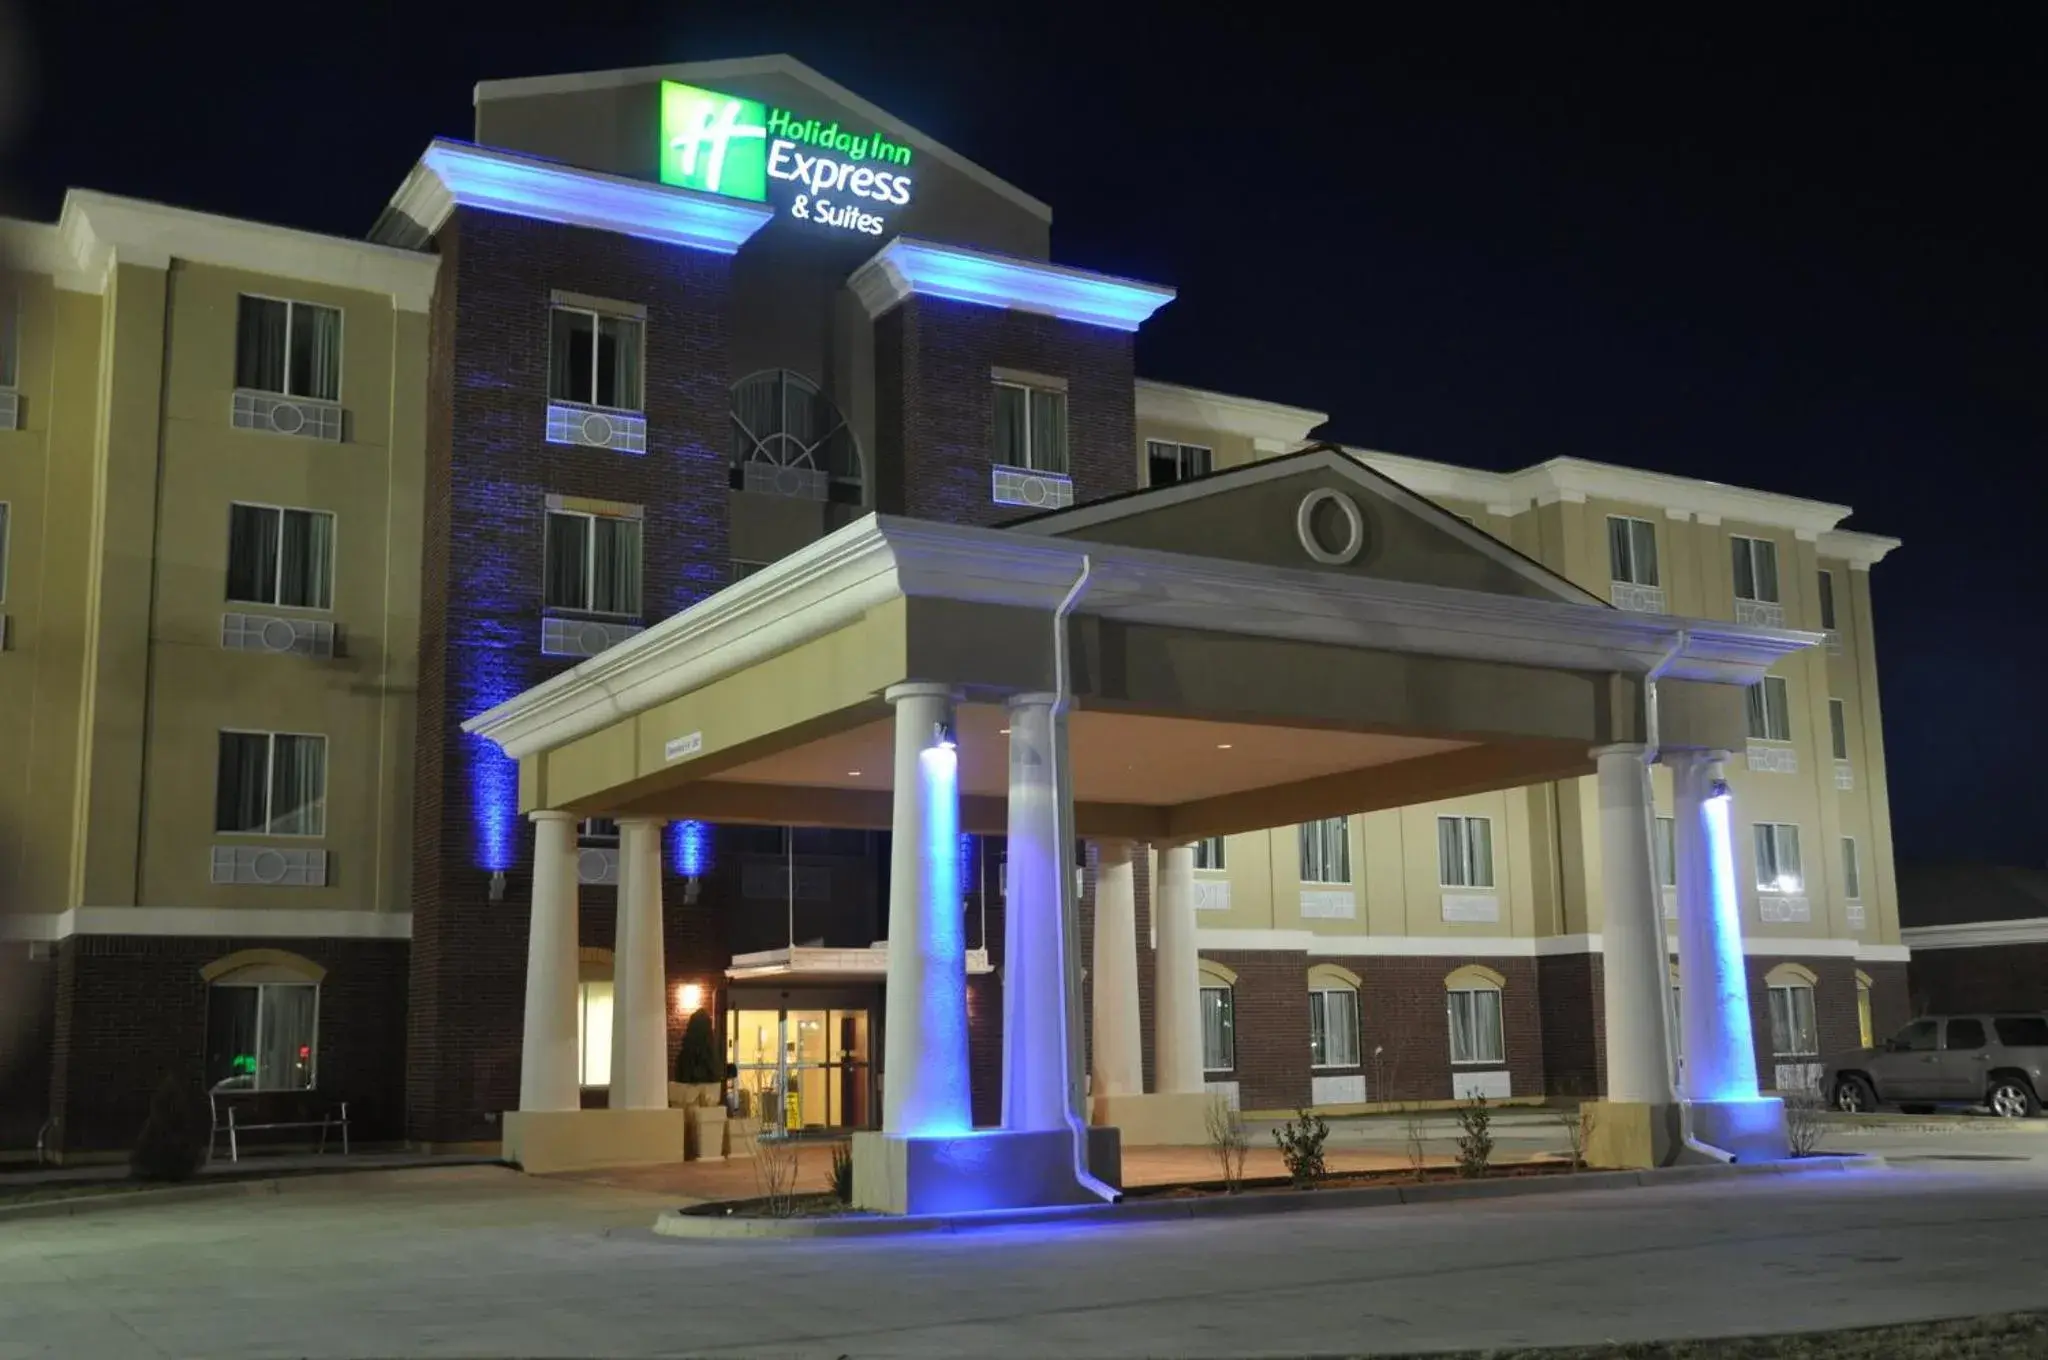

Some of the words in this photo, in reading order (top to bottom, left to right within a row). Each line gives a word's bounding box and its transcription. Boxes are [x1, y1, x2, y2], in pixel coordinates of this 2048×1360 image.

[768, 108, 868, 160] Holiday
[871, 133, 912, 165] Inn
[767, 140, 912, 205] Express
[791, 194, 809, 218] &
[814, 200, 884, 235] Suites
